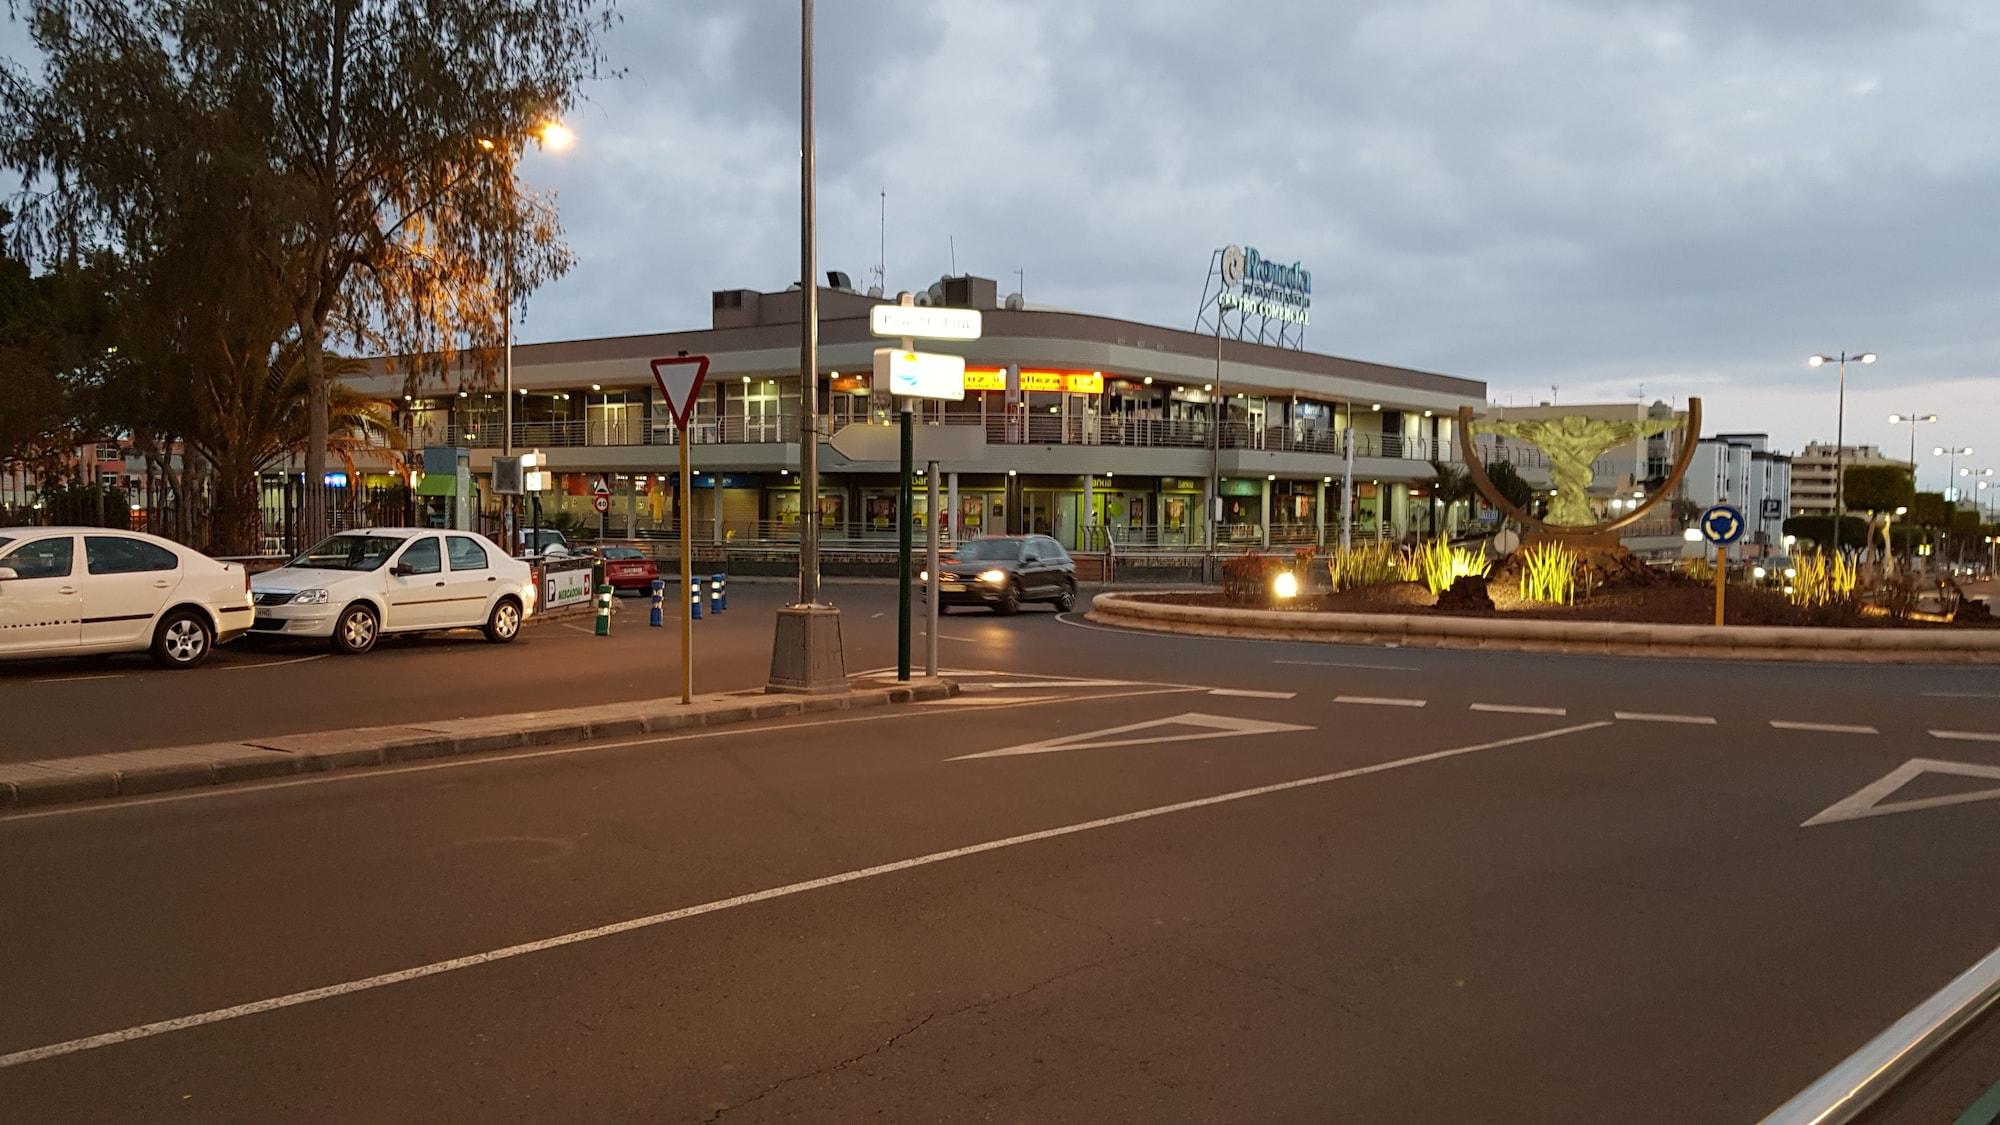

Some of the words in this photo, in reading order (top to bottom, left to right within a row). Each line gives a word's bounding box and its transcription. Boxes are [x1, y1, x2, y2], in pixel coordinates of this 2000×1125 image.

[1244, 246, 1312, 295] Ronda
[1219, 293, 1257, 314] CENTRO
[1259, 302, 1310, 326] COMERCIAL
[1092, 478, 1112, 488] ankia
